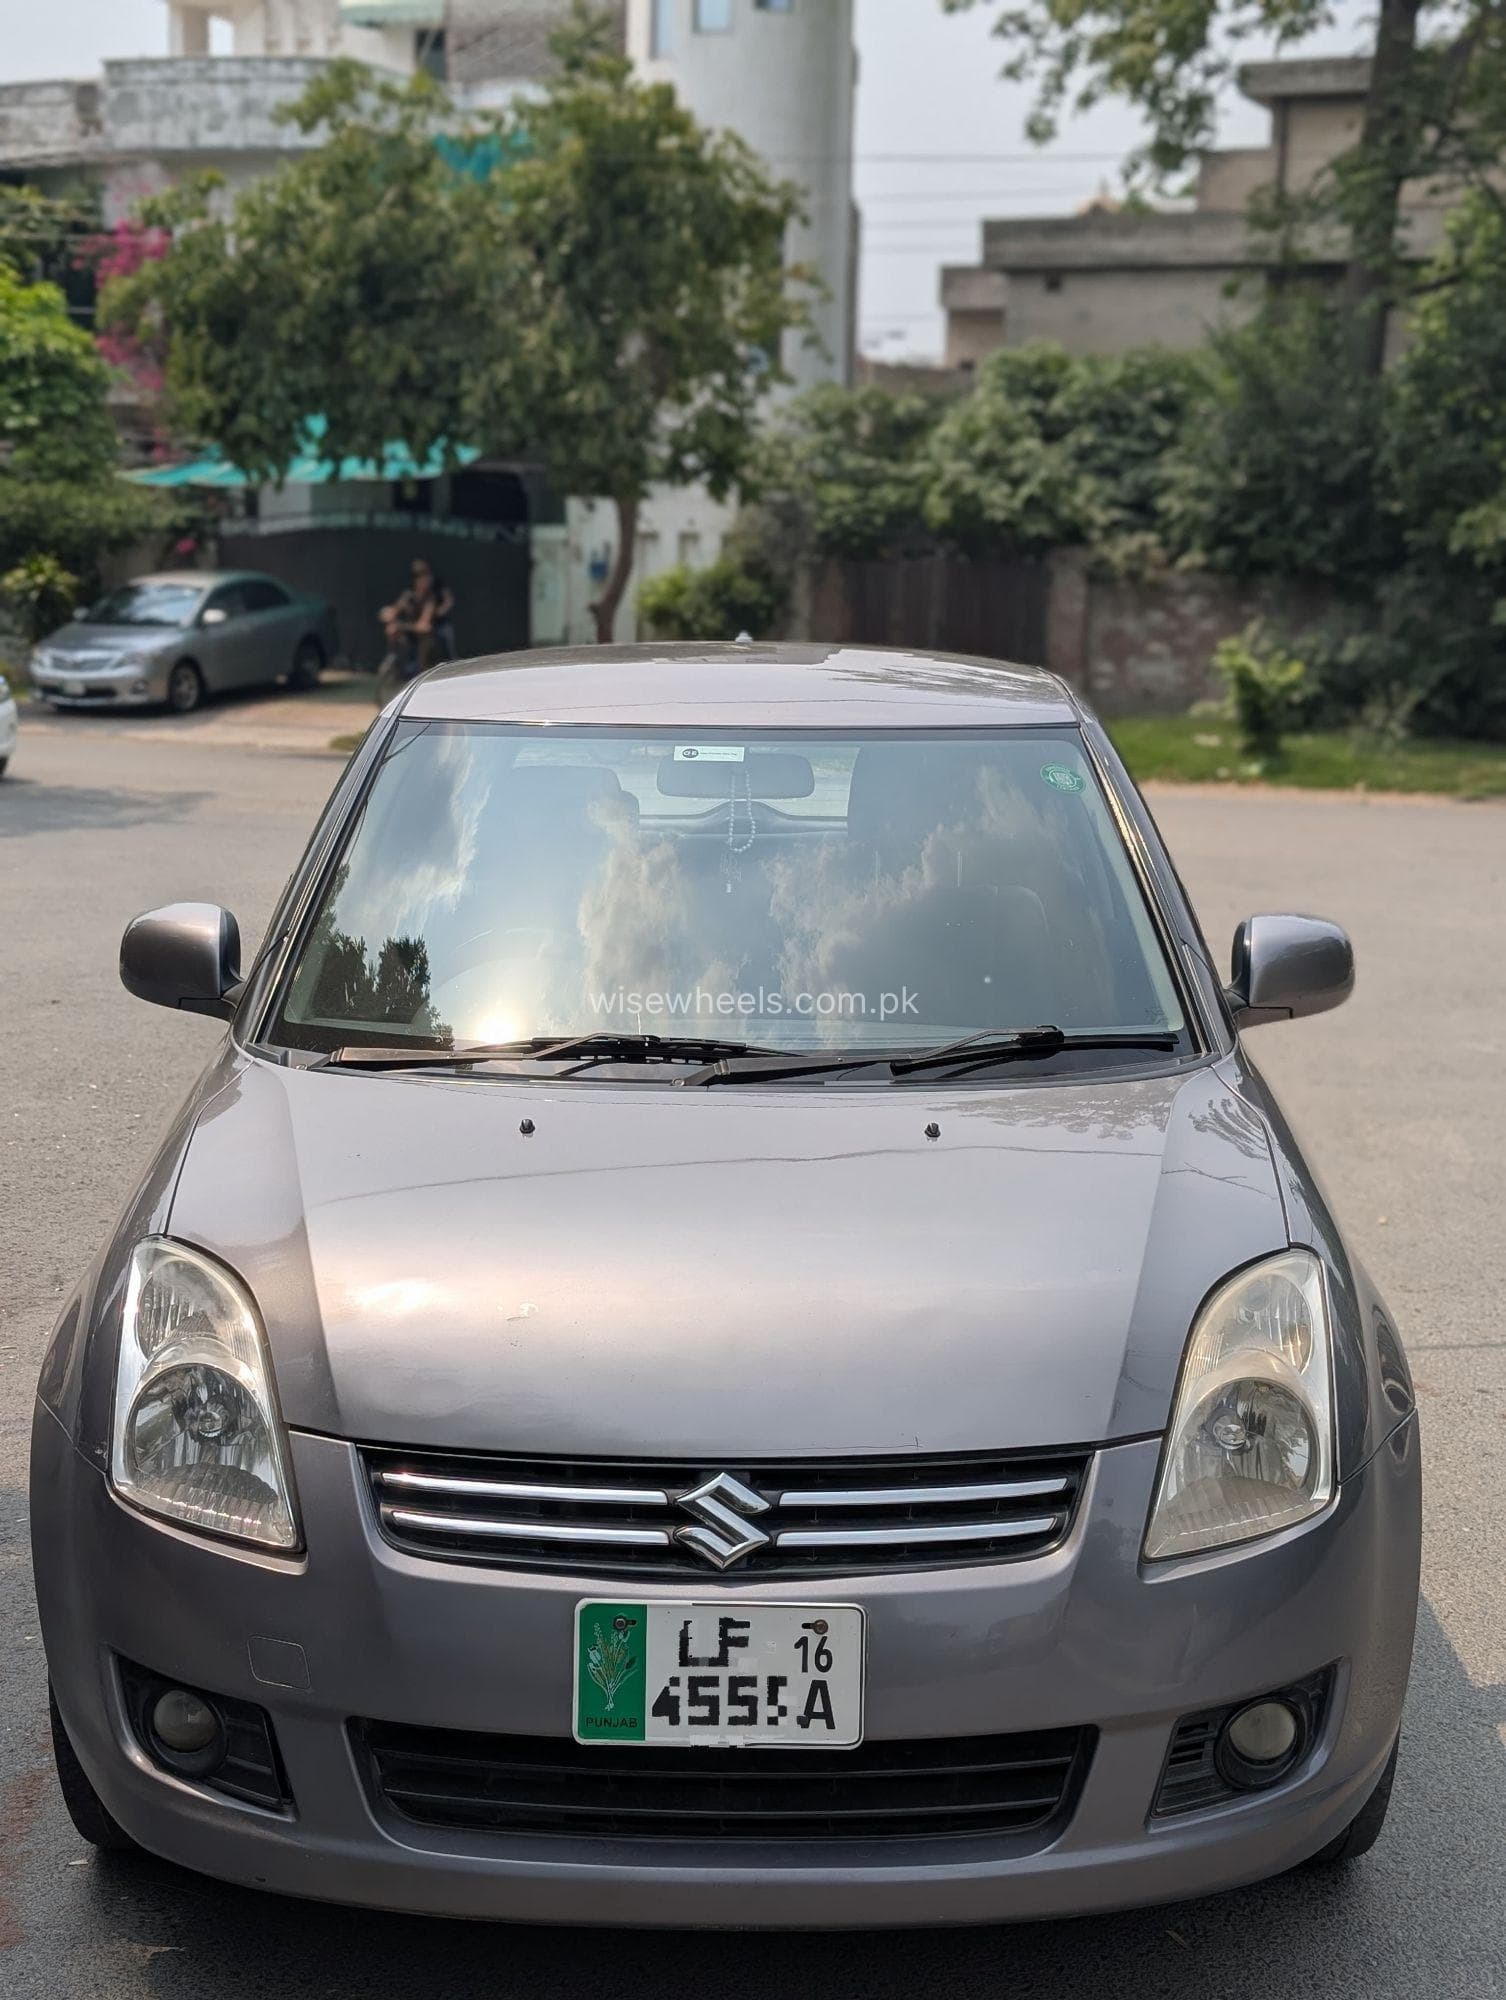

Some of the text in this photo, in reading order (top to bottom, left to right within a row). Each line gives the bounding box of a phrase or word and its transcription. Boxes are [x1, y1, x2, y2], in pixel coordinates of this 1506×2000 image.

[794, 1636, 833, 1673] 16
[586, 1717, 637, 1728] PUNJAB
[802, 1680, 836, 1729] A
